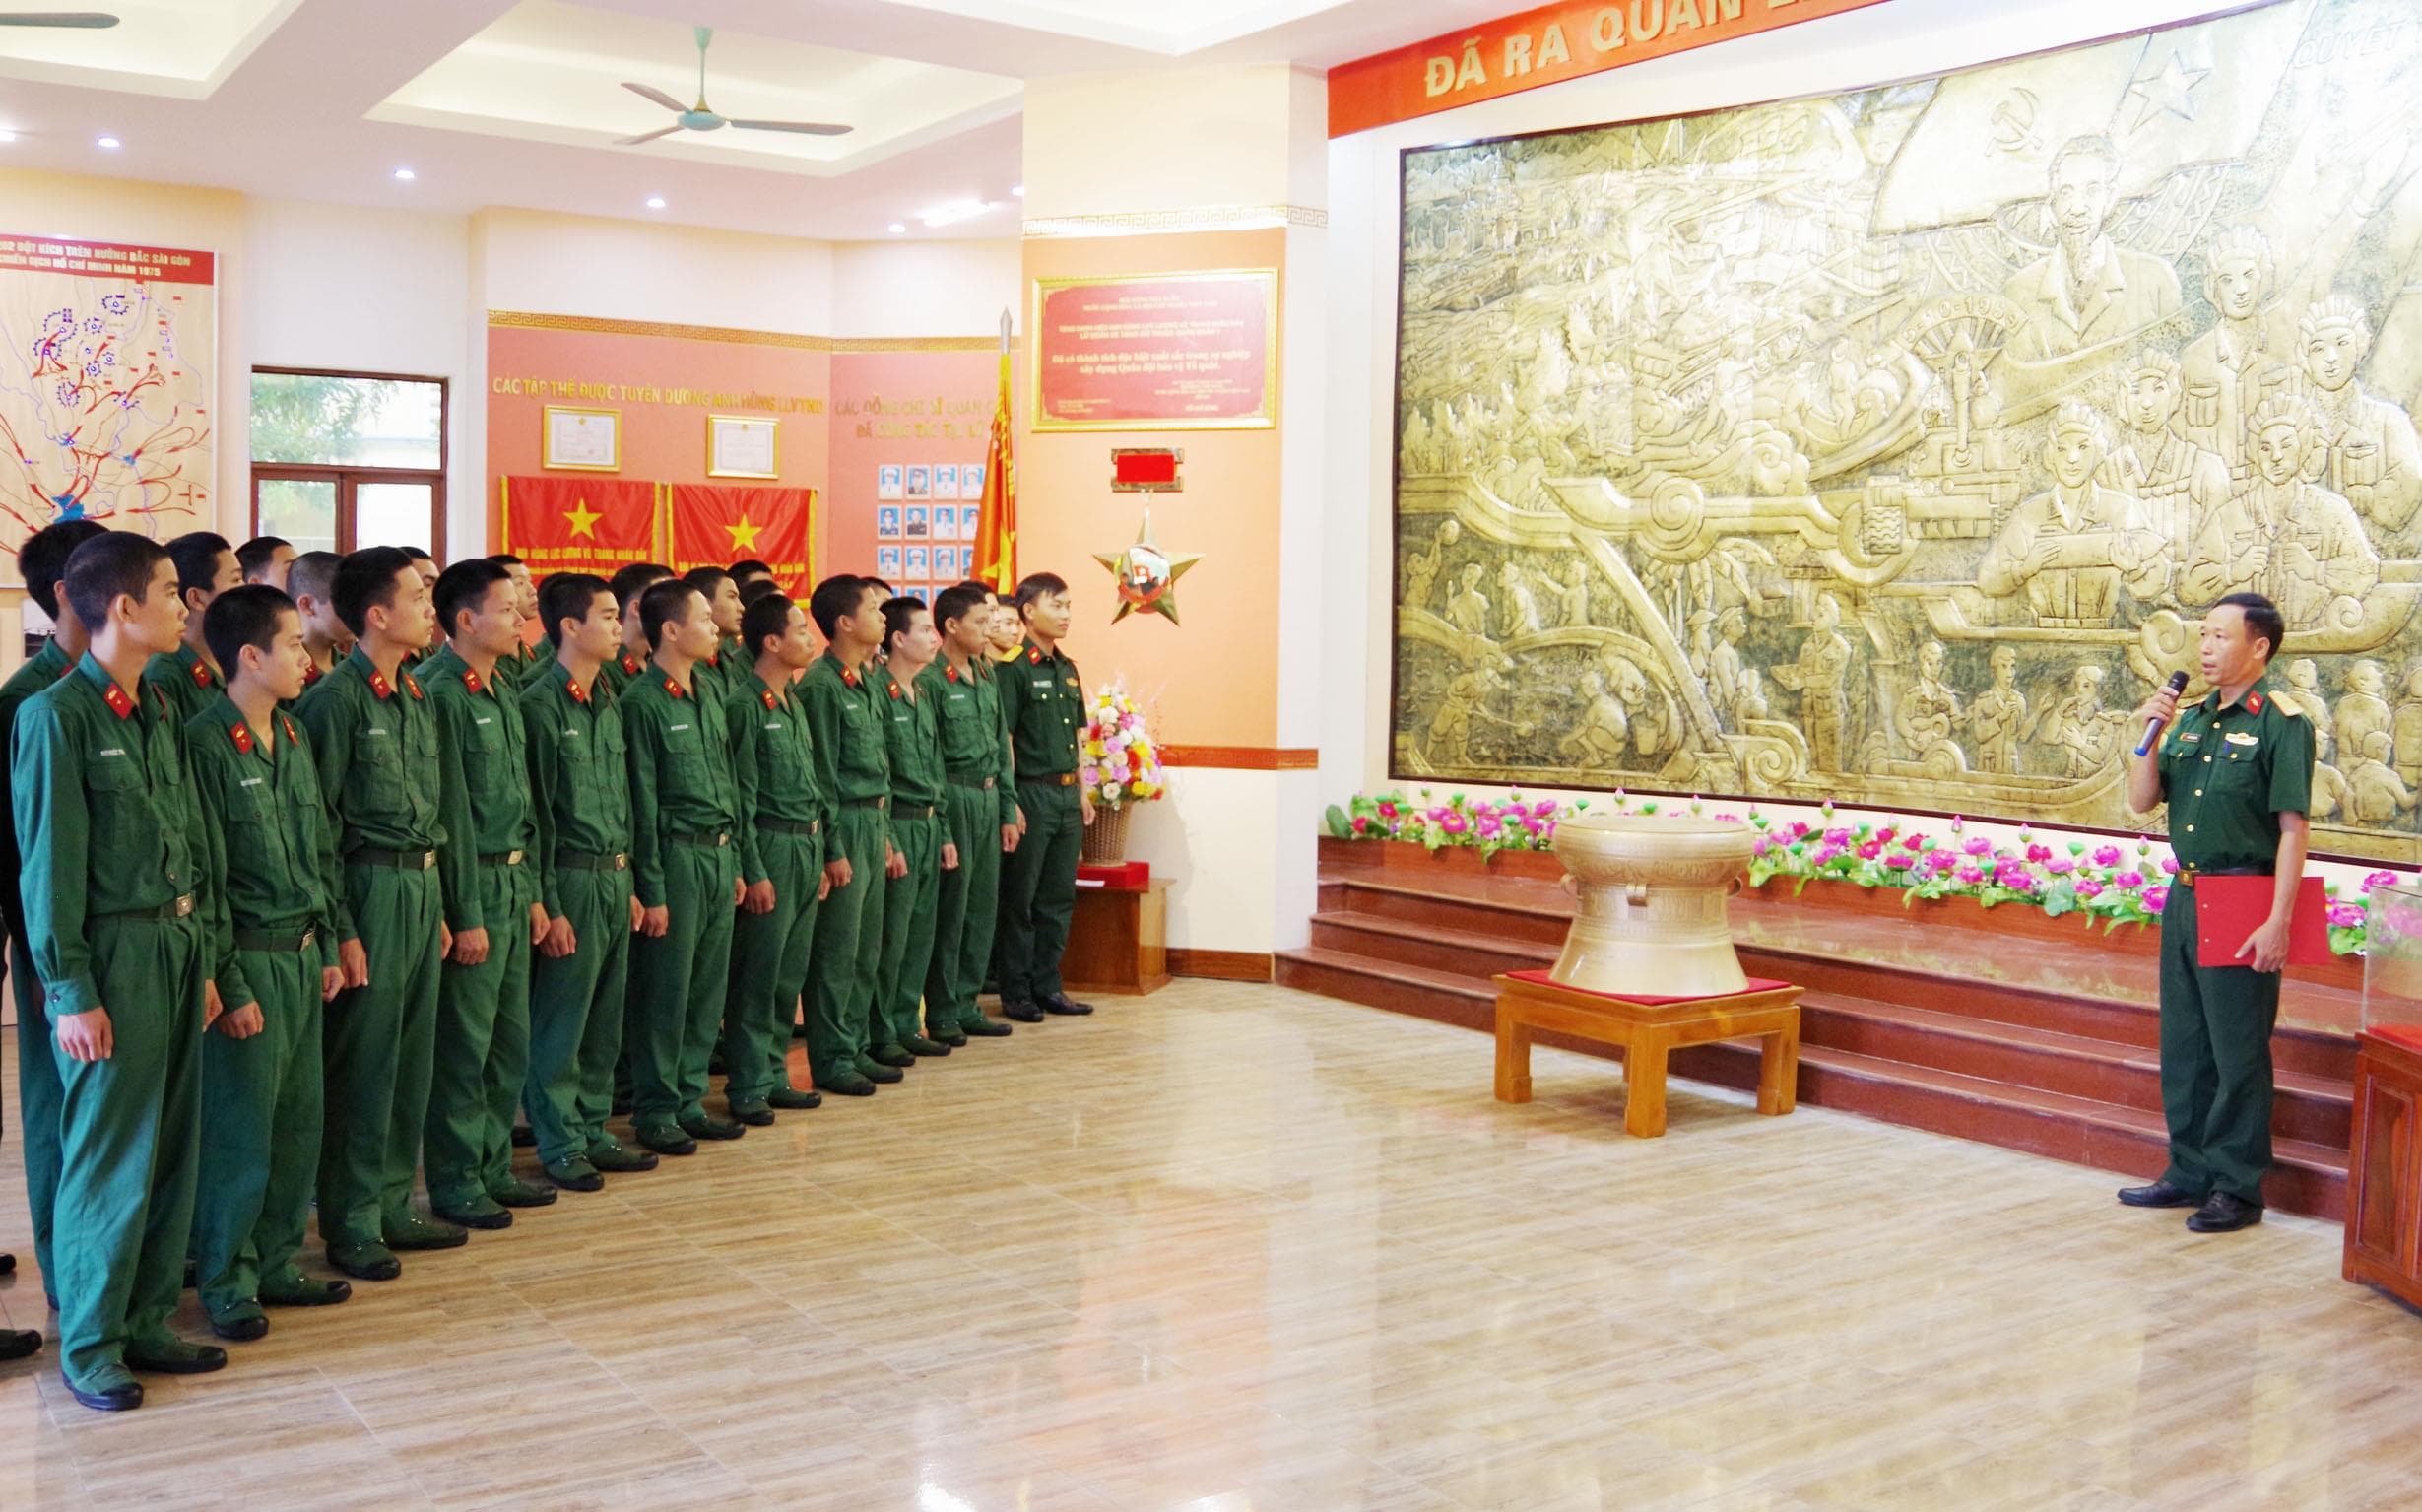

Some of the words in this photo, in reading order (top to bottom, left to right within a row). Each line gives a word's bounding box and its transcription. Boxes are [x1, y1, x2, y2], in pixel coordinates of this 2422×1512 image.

[1424, 36, 1488, 98] ĐÃ
[1503, 23, 1572, 78] RA
[492, 374, 521, 395] CÁC
